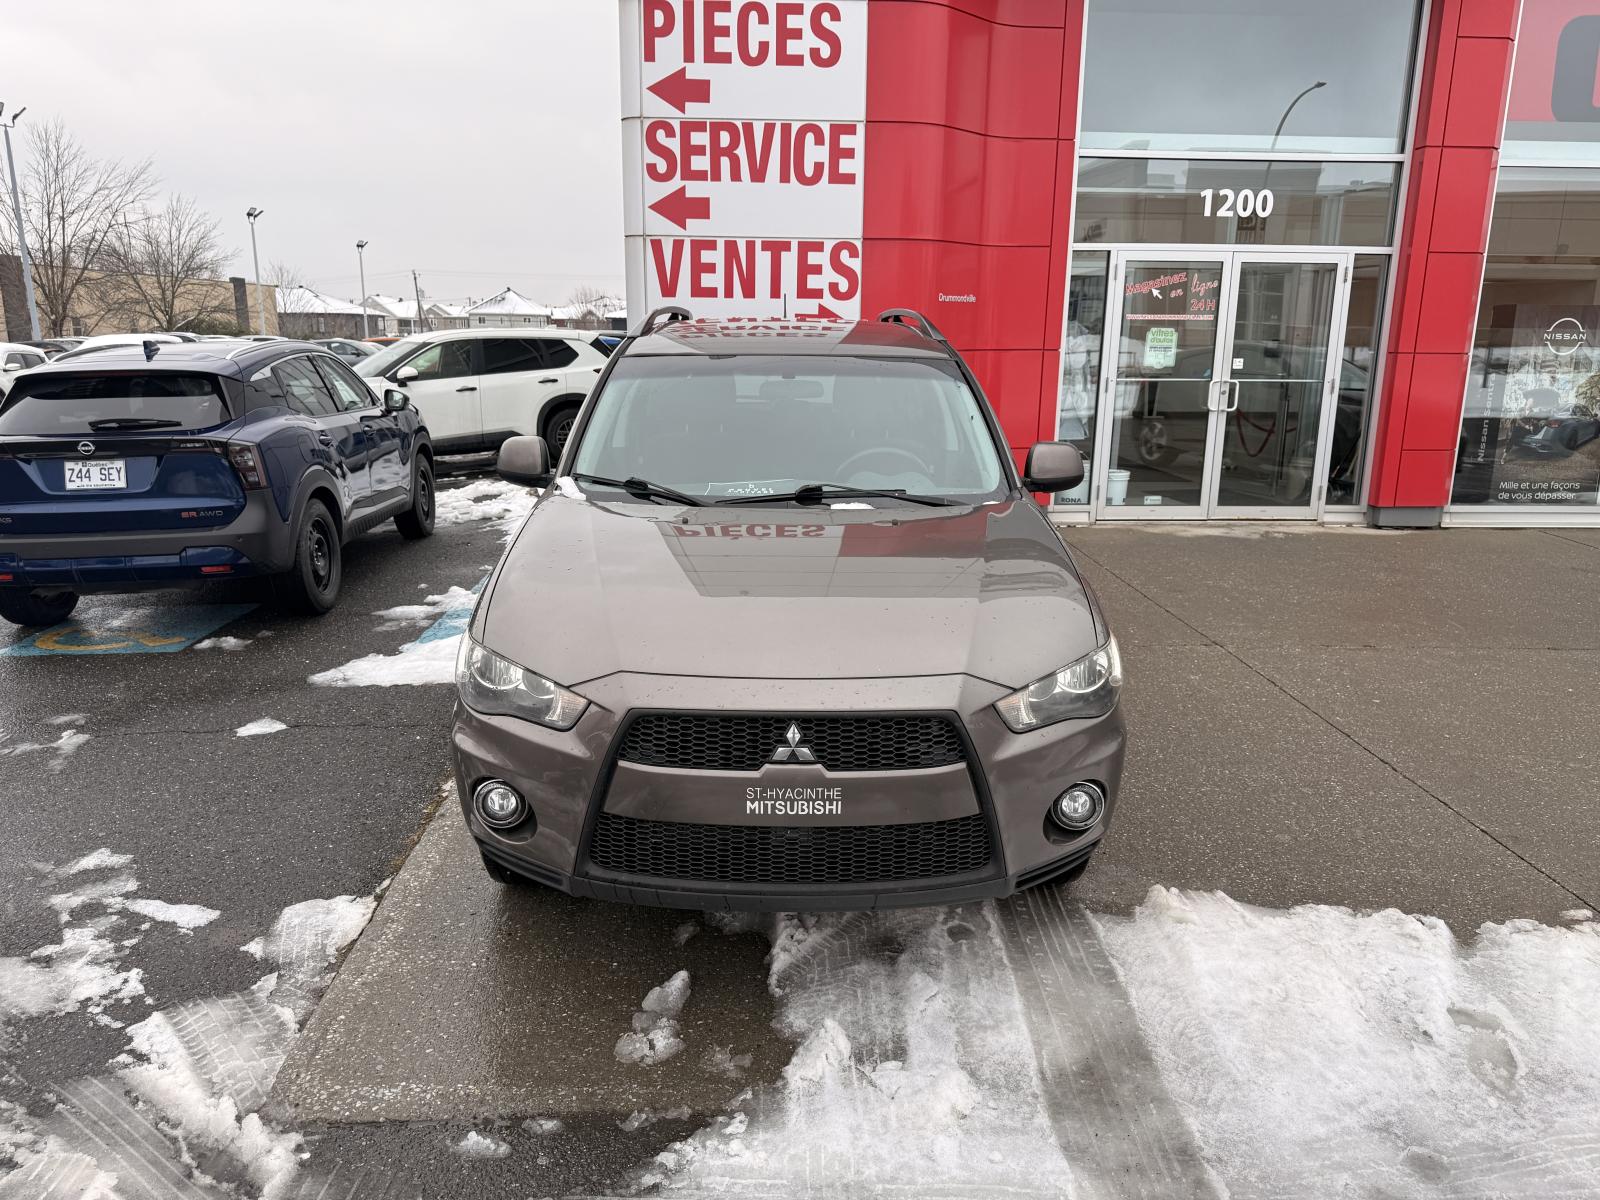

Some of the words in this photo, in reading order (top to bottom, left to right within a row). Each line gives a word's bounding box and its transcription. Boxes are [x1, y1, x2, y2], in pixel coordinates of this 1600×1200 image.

[645, 120, 857, 186] SERVICE
[1200, 188, 1274, 218] 1200
[650, 239, 860, 301] VENTES
[1191, 273, 1219, 297] ligne
[939, 293, 977, 302] Drummondville
[1543, 333, 1587, 341] NISSAN
[1477, 420, 1489, 462] Nissan
[67, 467, 91, 482] Z44
[100, 466, 122, 481] SEY
[1499, 481, 1519, 489] Mille
[1550, 481, 1580, 491] façons
[1498, 491, 1510, 499] de
[1534, 491, 1577, 500] dépasser.
[746, 787, 842, 799] ST-HYACINTHE
[746, 800, 842, 815] MITSUBISHI
